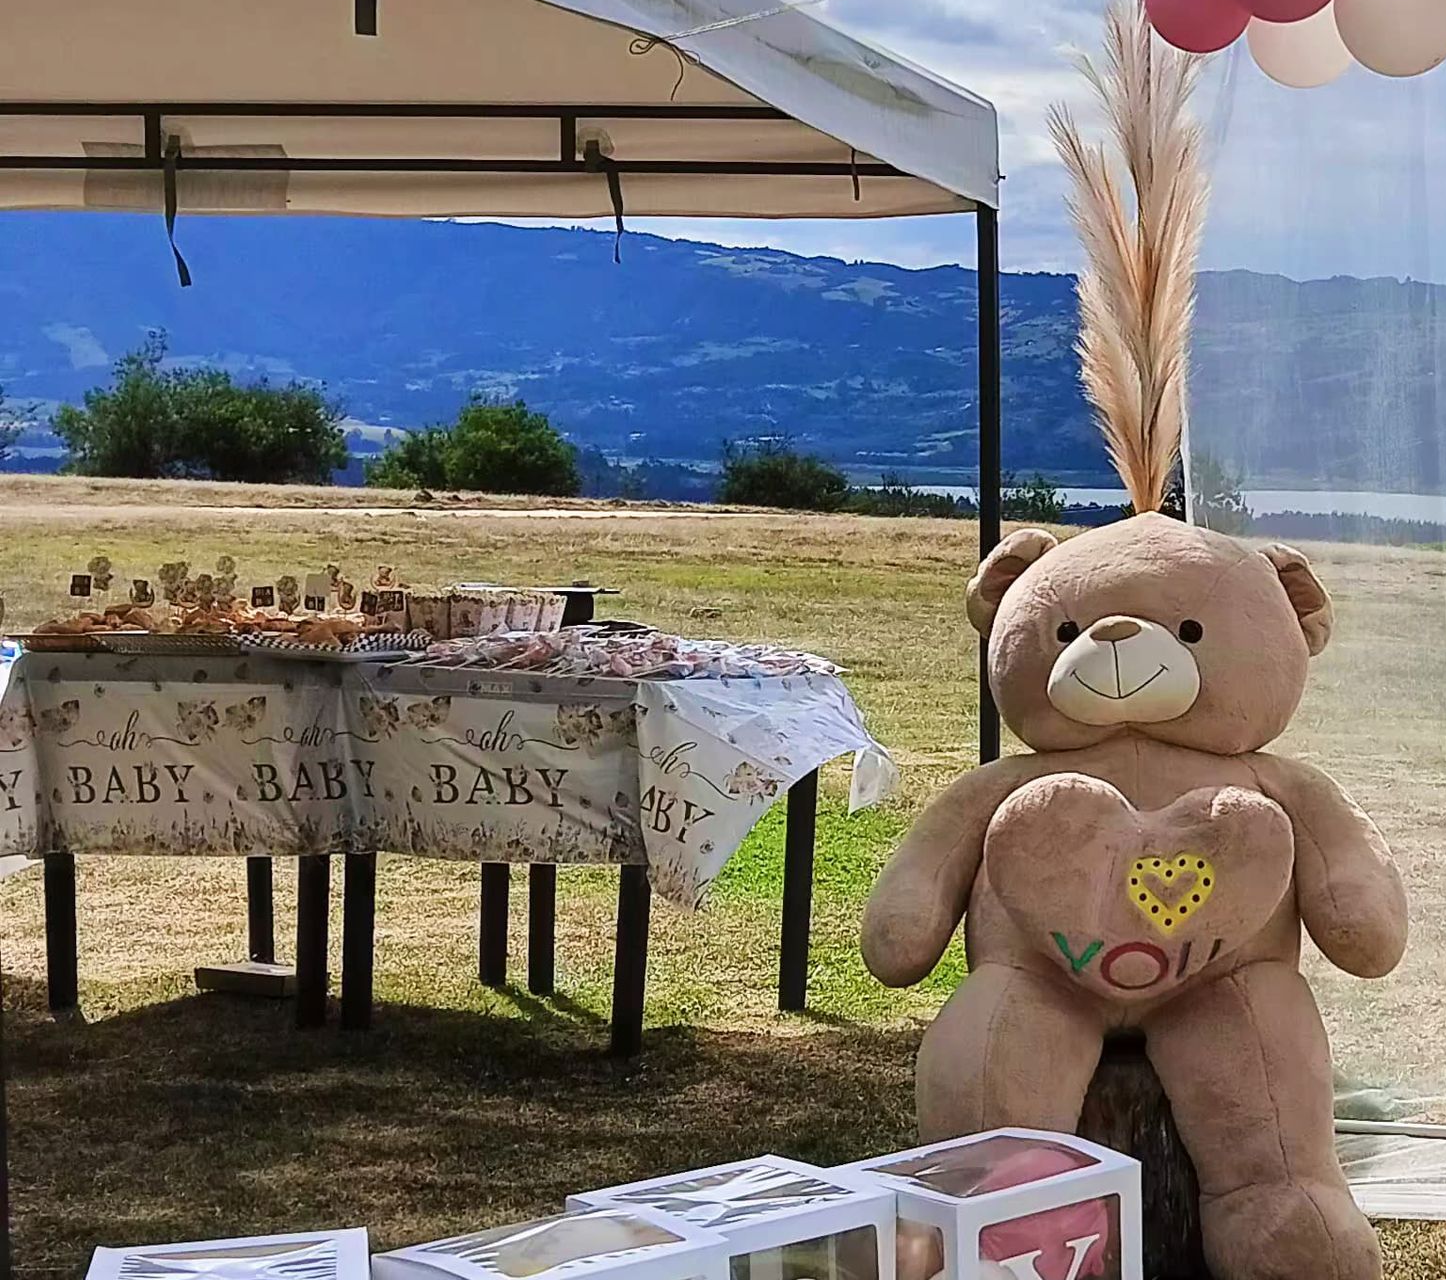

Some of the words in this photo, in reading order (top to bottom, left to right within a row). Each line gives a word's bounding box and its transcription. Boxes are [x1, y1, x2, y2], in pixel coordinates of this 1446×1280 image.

[67, 763, 195, 805] BABY
[252, 759, 376, 803] BABY
[429, 763, 569, 808] BABY
[640, 784, 716, 845] ABY
